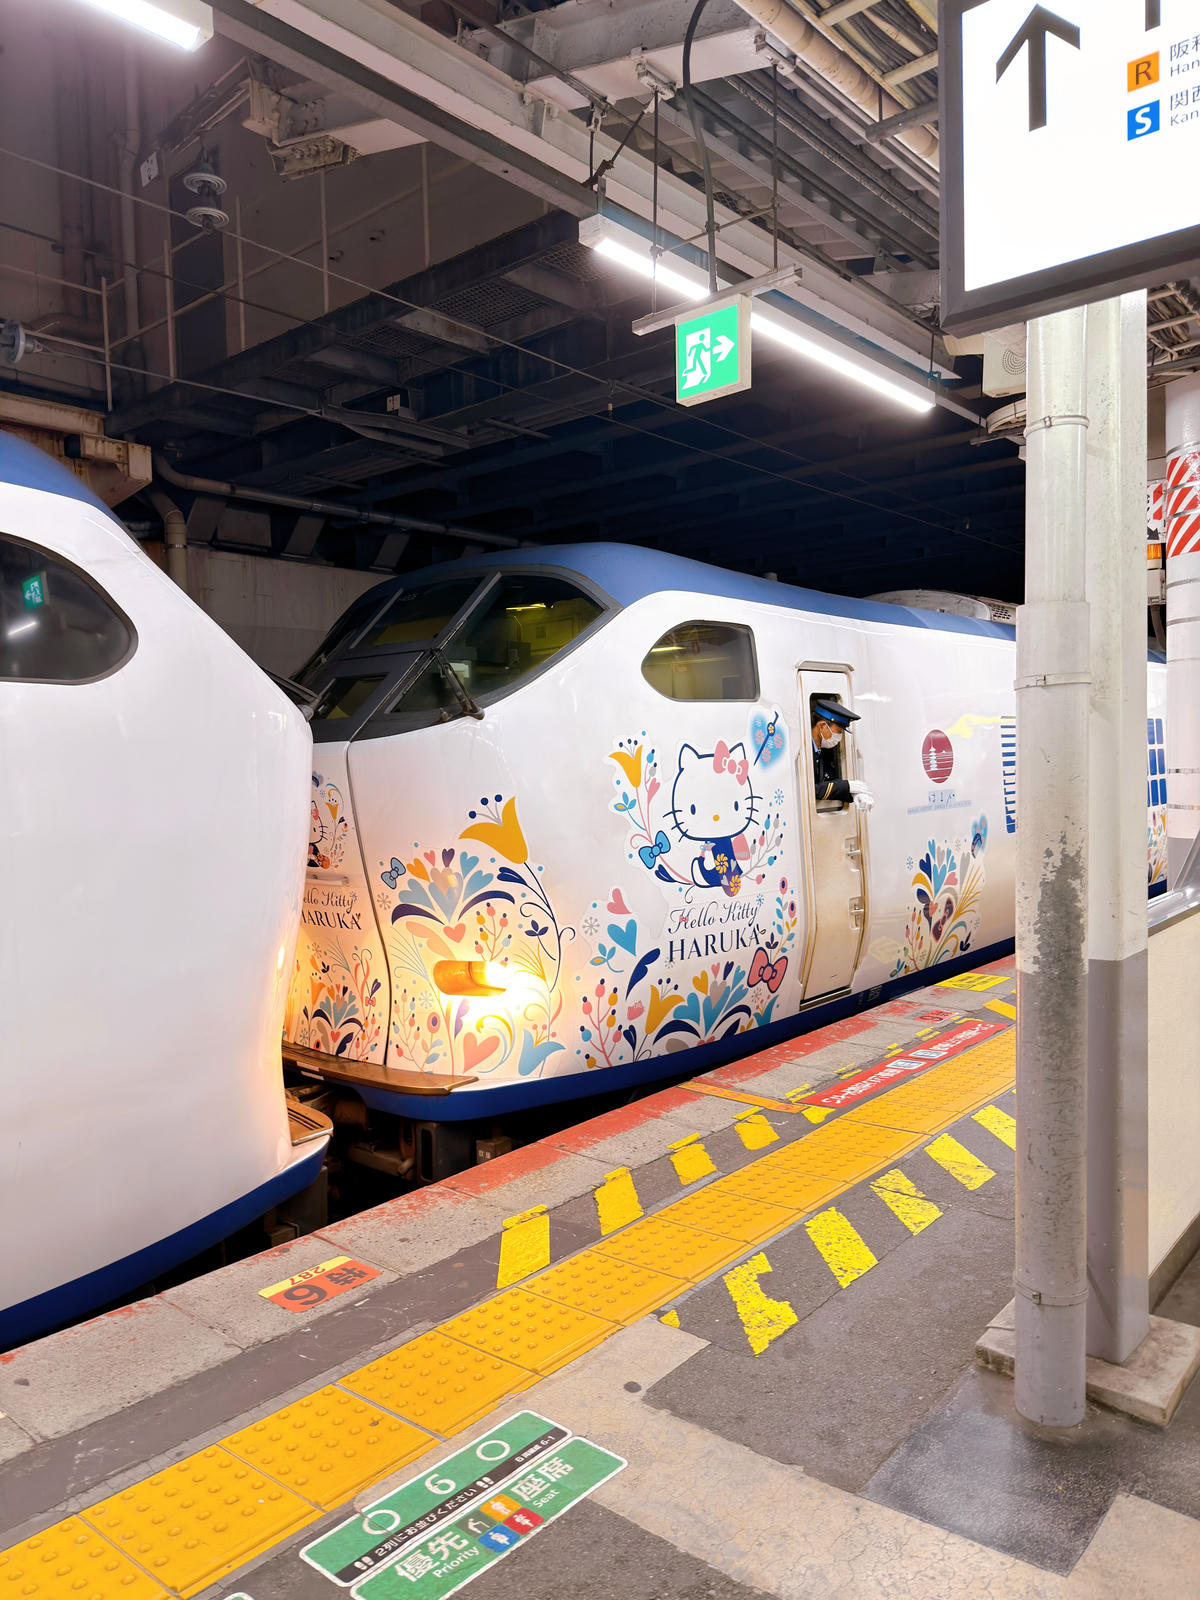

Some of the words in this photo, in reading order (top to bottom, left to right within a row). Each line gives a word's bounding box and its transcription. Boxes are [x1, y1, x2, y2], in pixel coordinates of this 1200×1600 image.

[1136, 61, 1152, 86] R
[1135, 106, 1152, 135] S
[303, 887, 319, 905] ello
[668, 901, 719, 934] Hello
[720, 901, 759, 927] Kitty
[669, 924, 761, 963] HARUKA
[290, 1265, 326, 1286] 287
[425, 1473, 456, 1495] 6
[375, 1488, 478, 1557] 2列にお並びください
[394, 1531, 470, 1583] 優先
[510, 1456, 574, 1502] 座席
[432, 1545, 480, 1578] Priority
[532, 1489, 560, 1508] Seat
